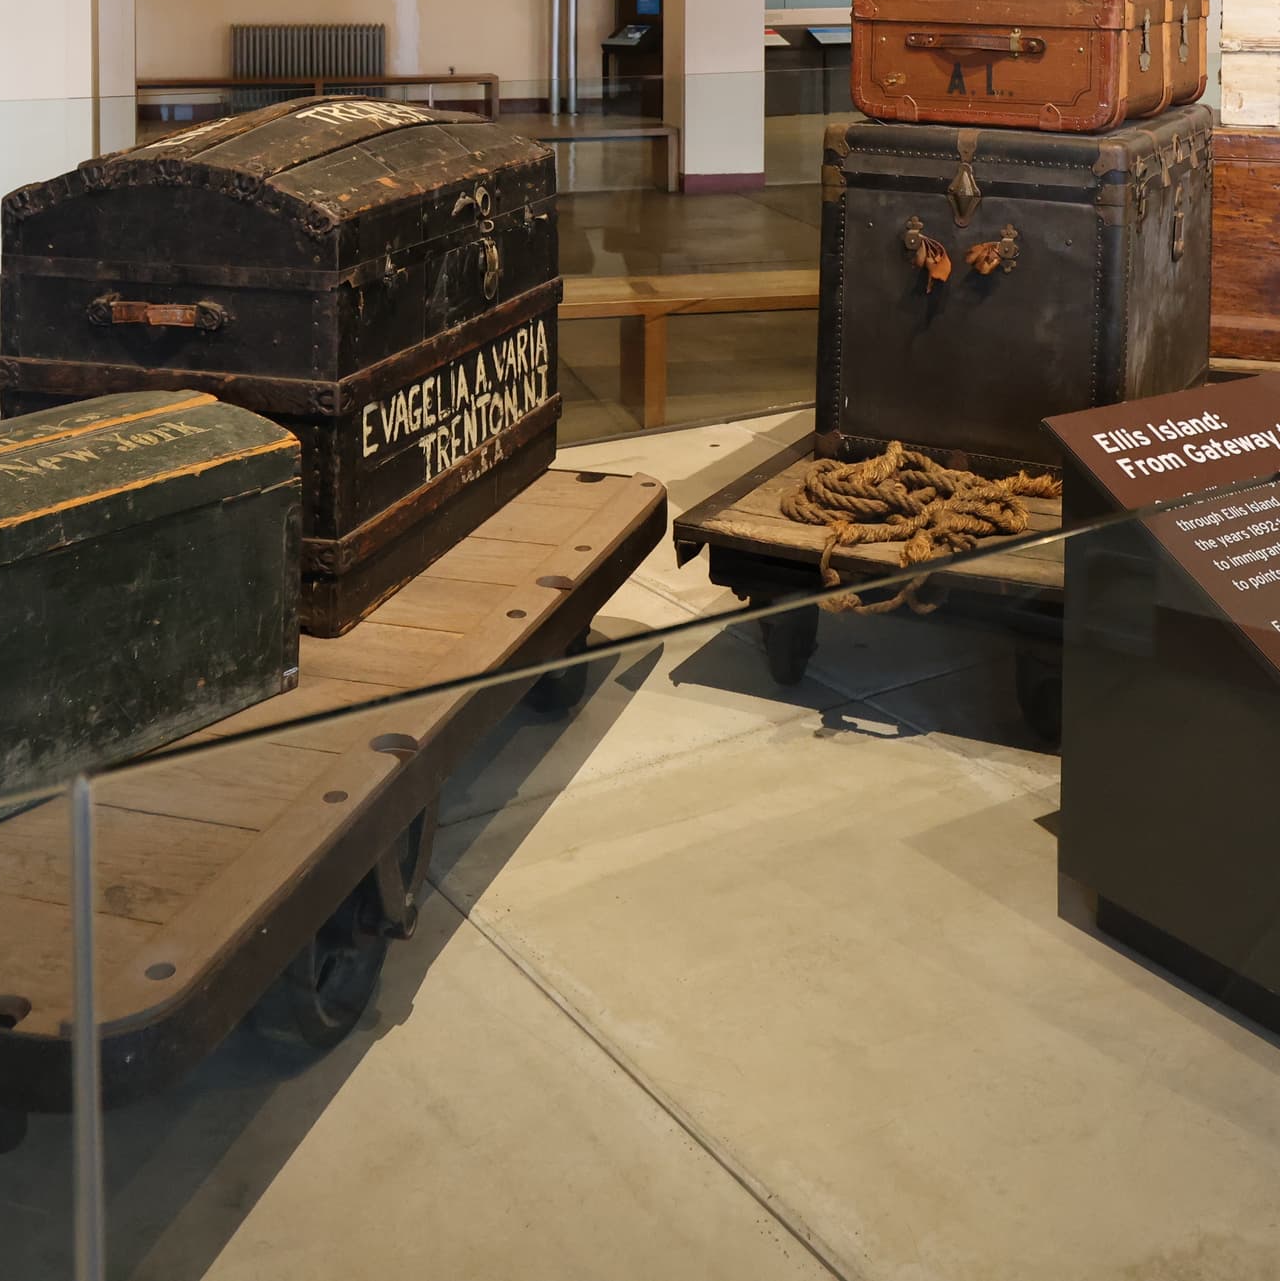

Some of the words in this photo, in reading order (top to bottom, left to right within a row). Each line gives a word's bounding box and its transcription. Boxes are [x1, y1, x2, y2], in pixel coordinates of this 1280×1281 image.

[492, 319, 548, 382] VARIA
[1092, 428, 1151, 453] Ellis
[1146, 411, 1228, 442] Island:
[1116, 452, 1187, 479] From
[1175, 512, 1225, 531] through
[1220, 506, 1248, 520] Ellis
[1194, 539, 1218, 551] the
[1216, 530, 1251, 548] years
[1213, 560, 1231, 571] to
[1232, 580, 1250, 591] to
